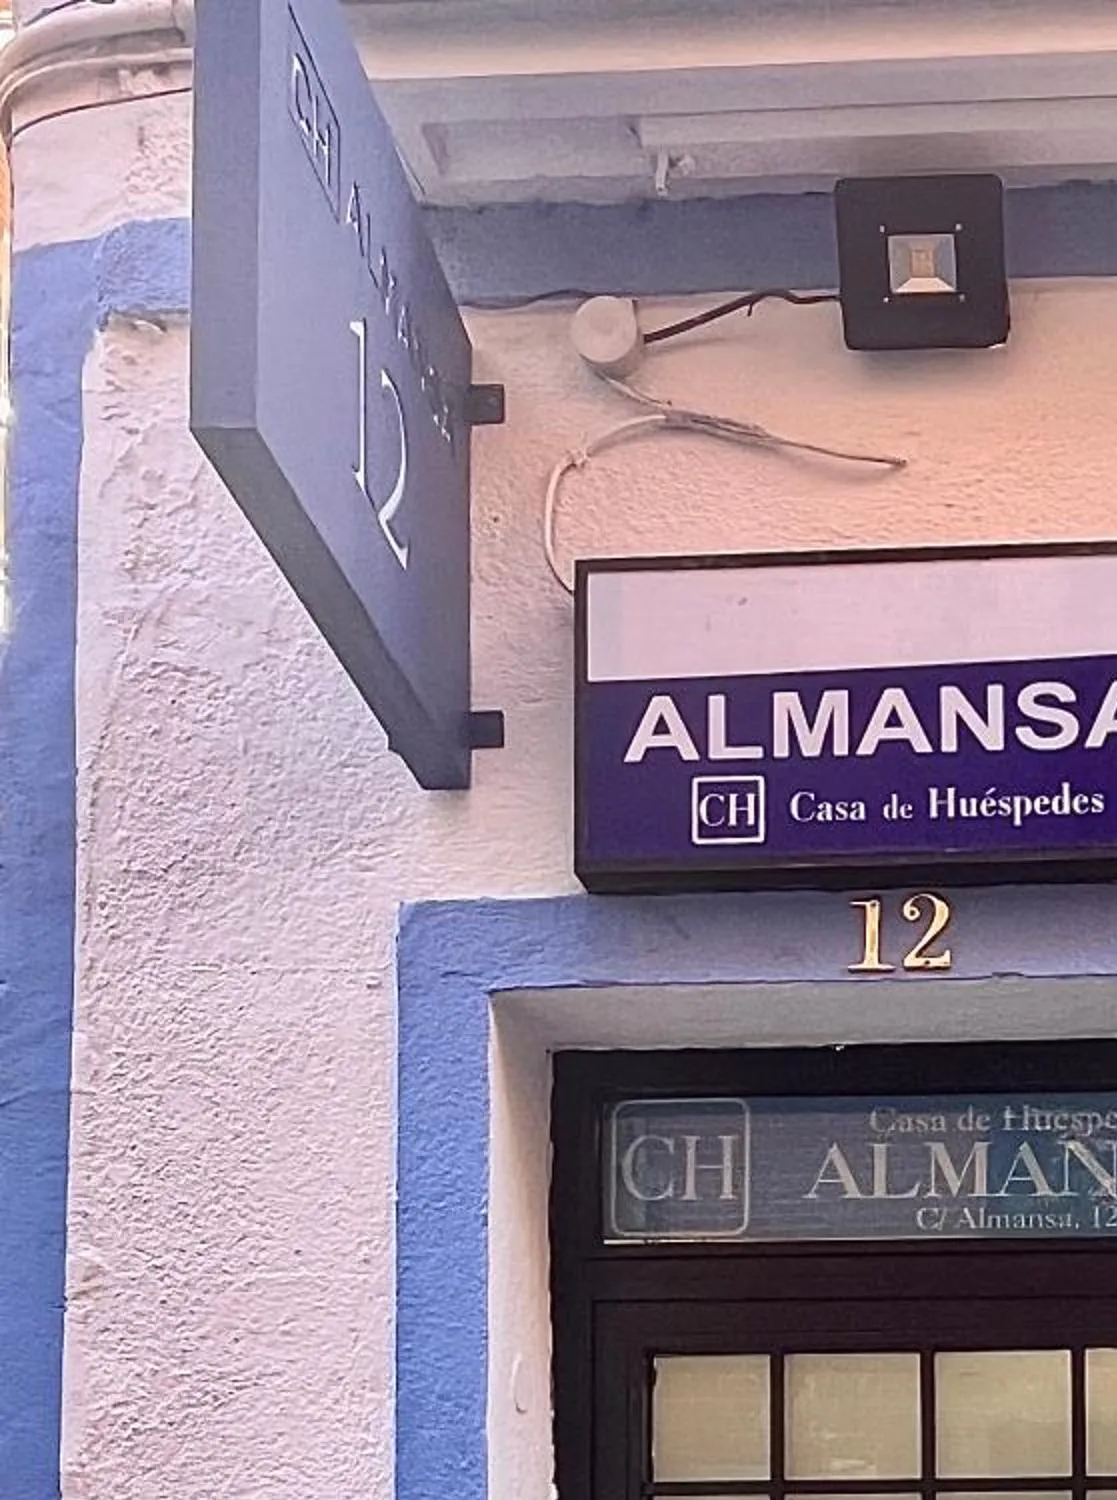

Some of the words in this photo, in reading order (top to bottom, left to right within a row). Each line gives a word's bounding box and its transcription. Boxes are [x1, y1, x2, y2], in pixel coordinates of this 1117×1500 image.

[349, 317, 408, 569] 12
[699, 792, 757, 827] CH
[790, 792, 867, 824] Casa
[883, 794, 914, 821] de
[928, 782, 1106, 827] Huéspedes
[846, 893, 953, 973] 12
[868, 1106, 946, 1135] Casa
[958, 1106, 991, 1133] de
[621, 1134, 738, 1201] CH
